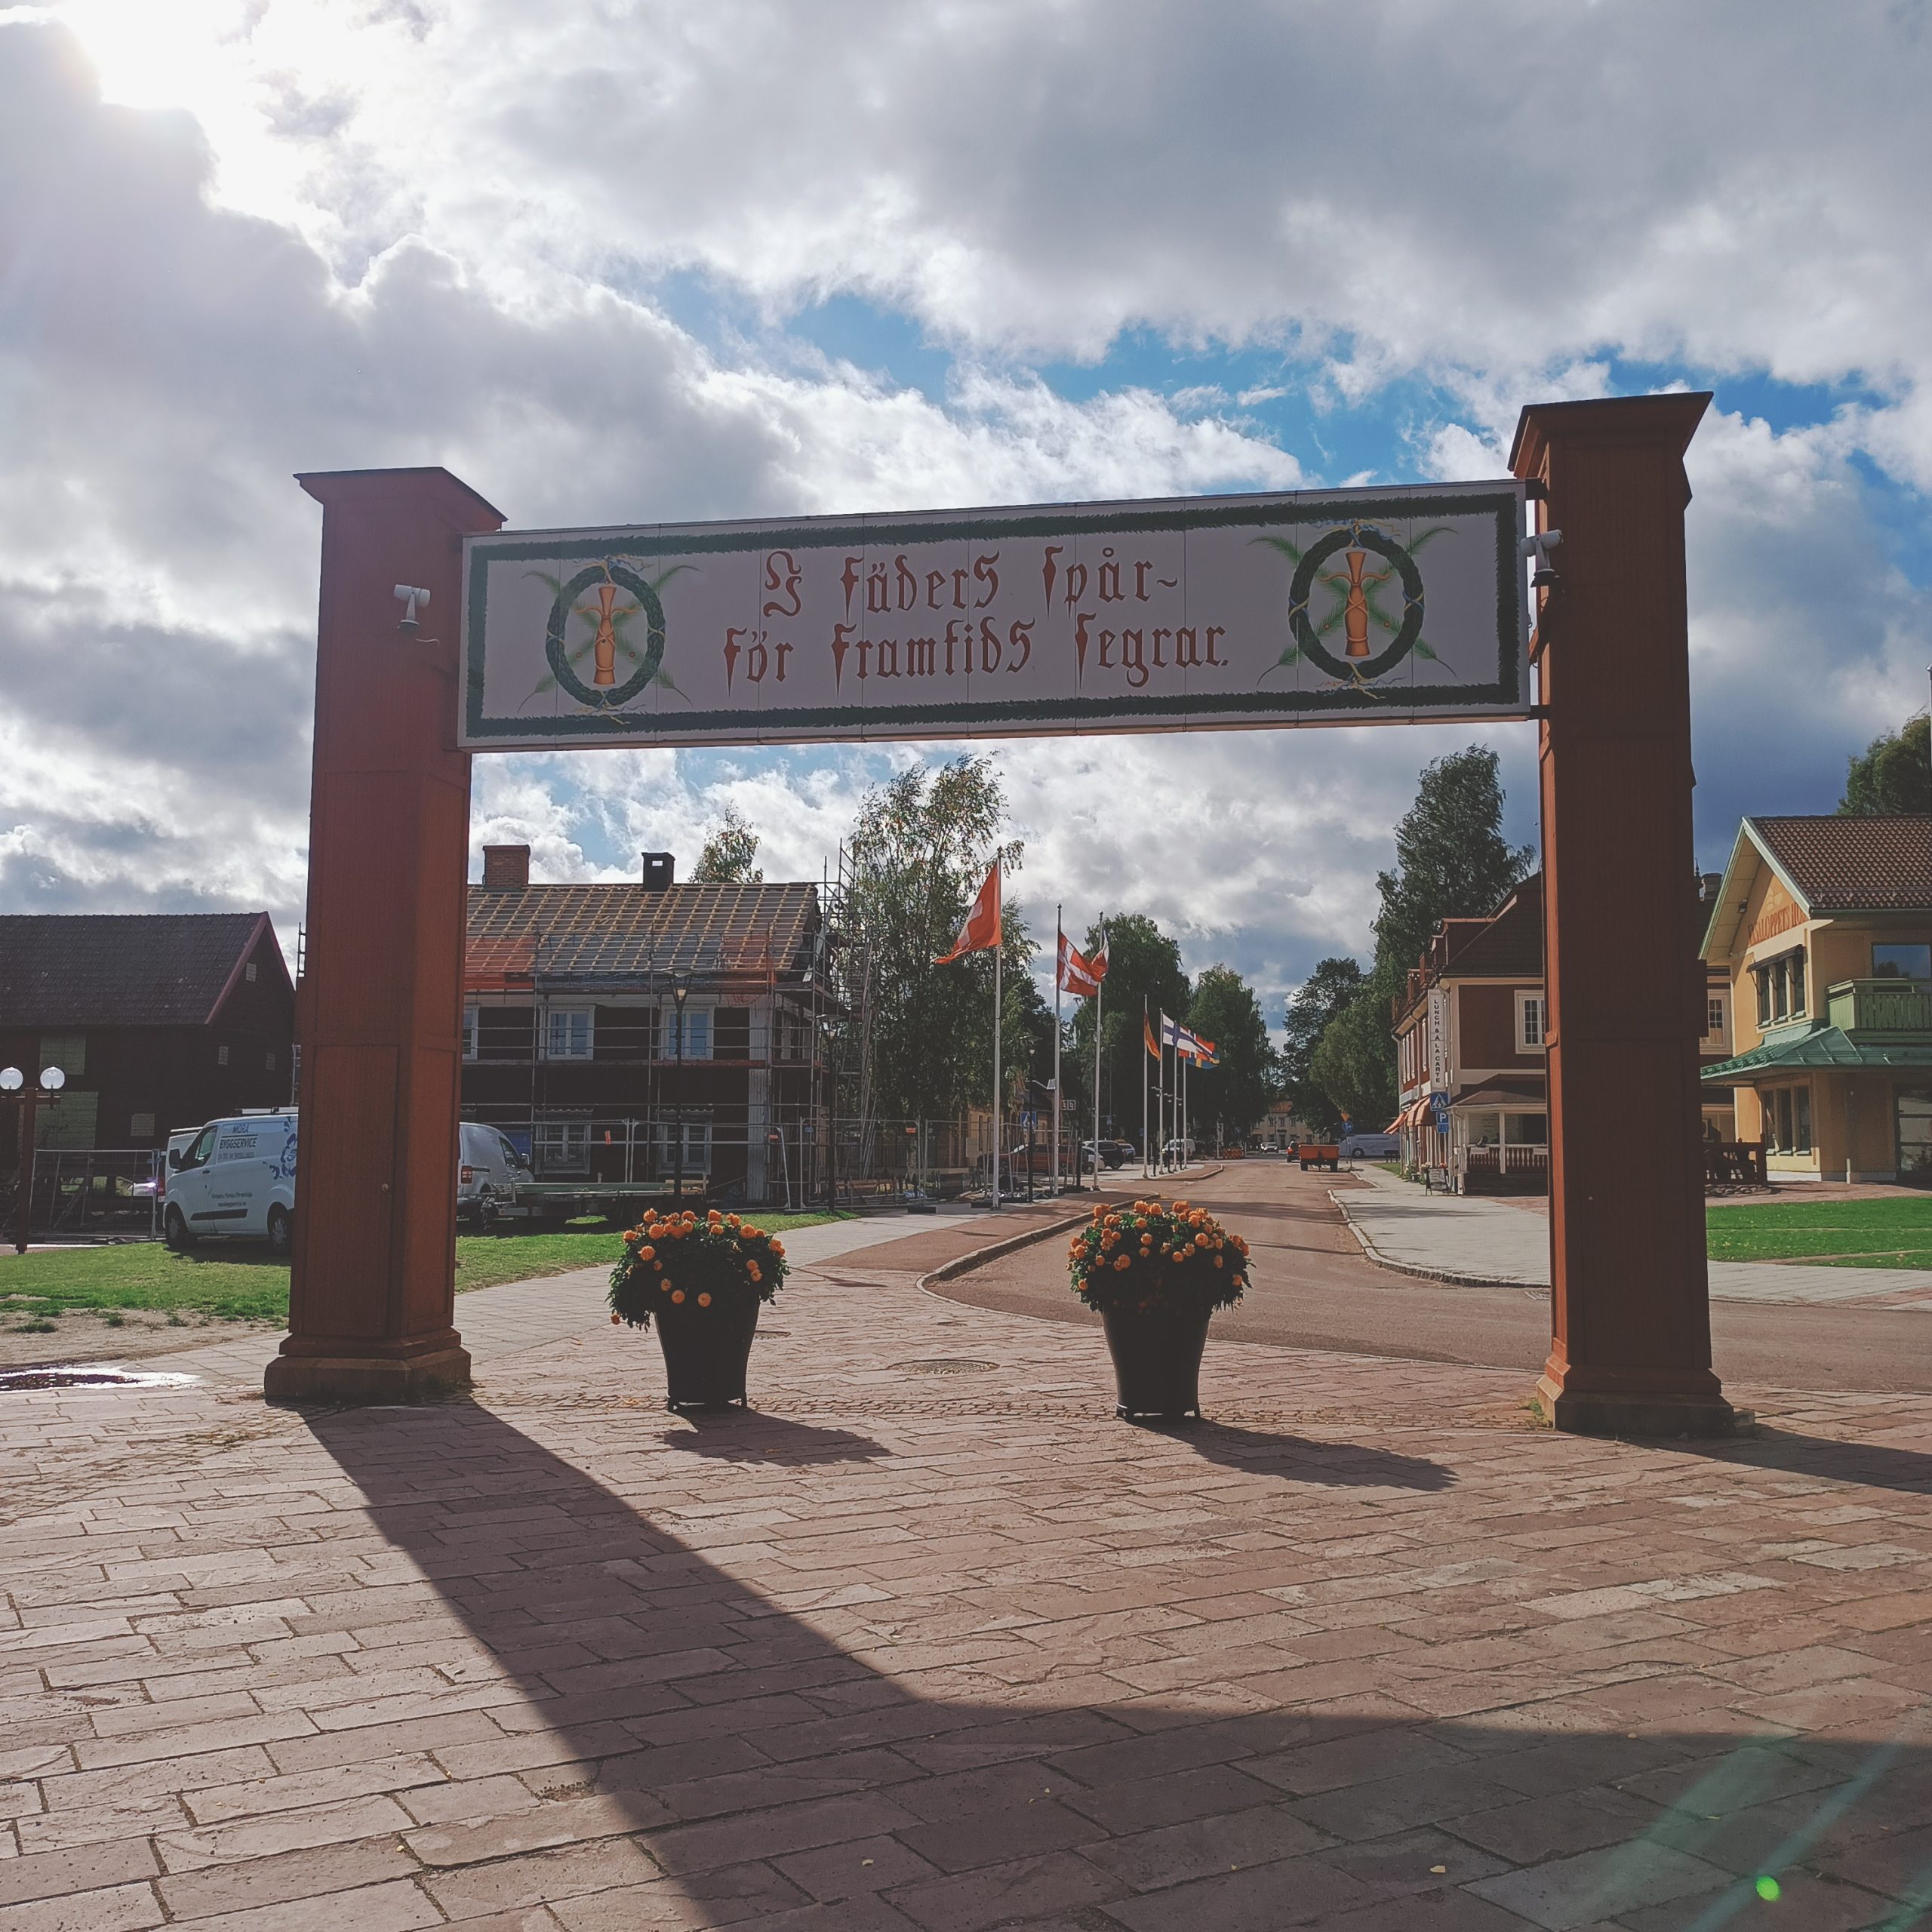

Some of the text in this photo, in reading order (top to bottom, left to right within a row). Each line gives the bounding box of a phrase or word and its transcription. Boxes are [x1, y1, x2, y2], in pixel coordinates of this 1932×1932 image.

[1439, 1113, 1447, 1122] P
[232, 1124, 249, 1134] MORA
[220, 1137, 257, 1149] BYGGSERVICE
